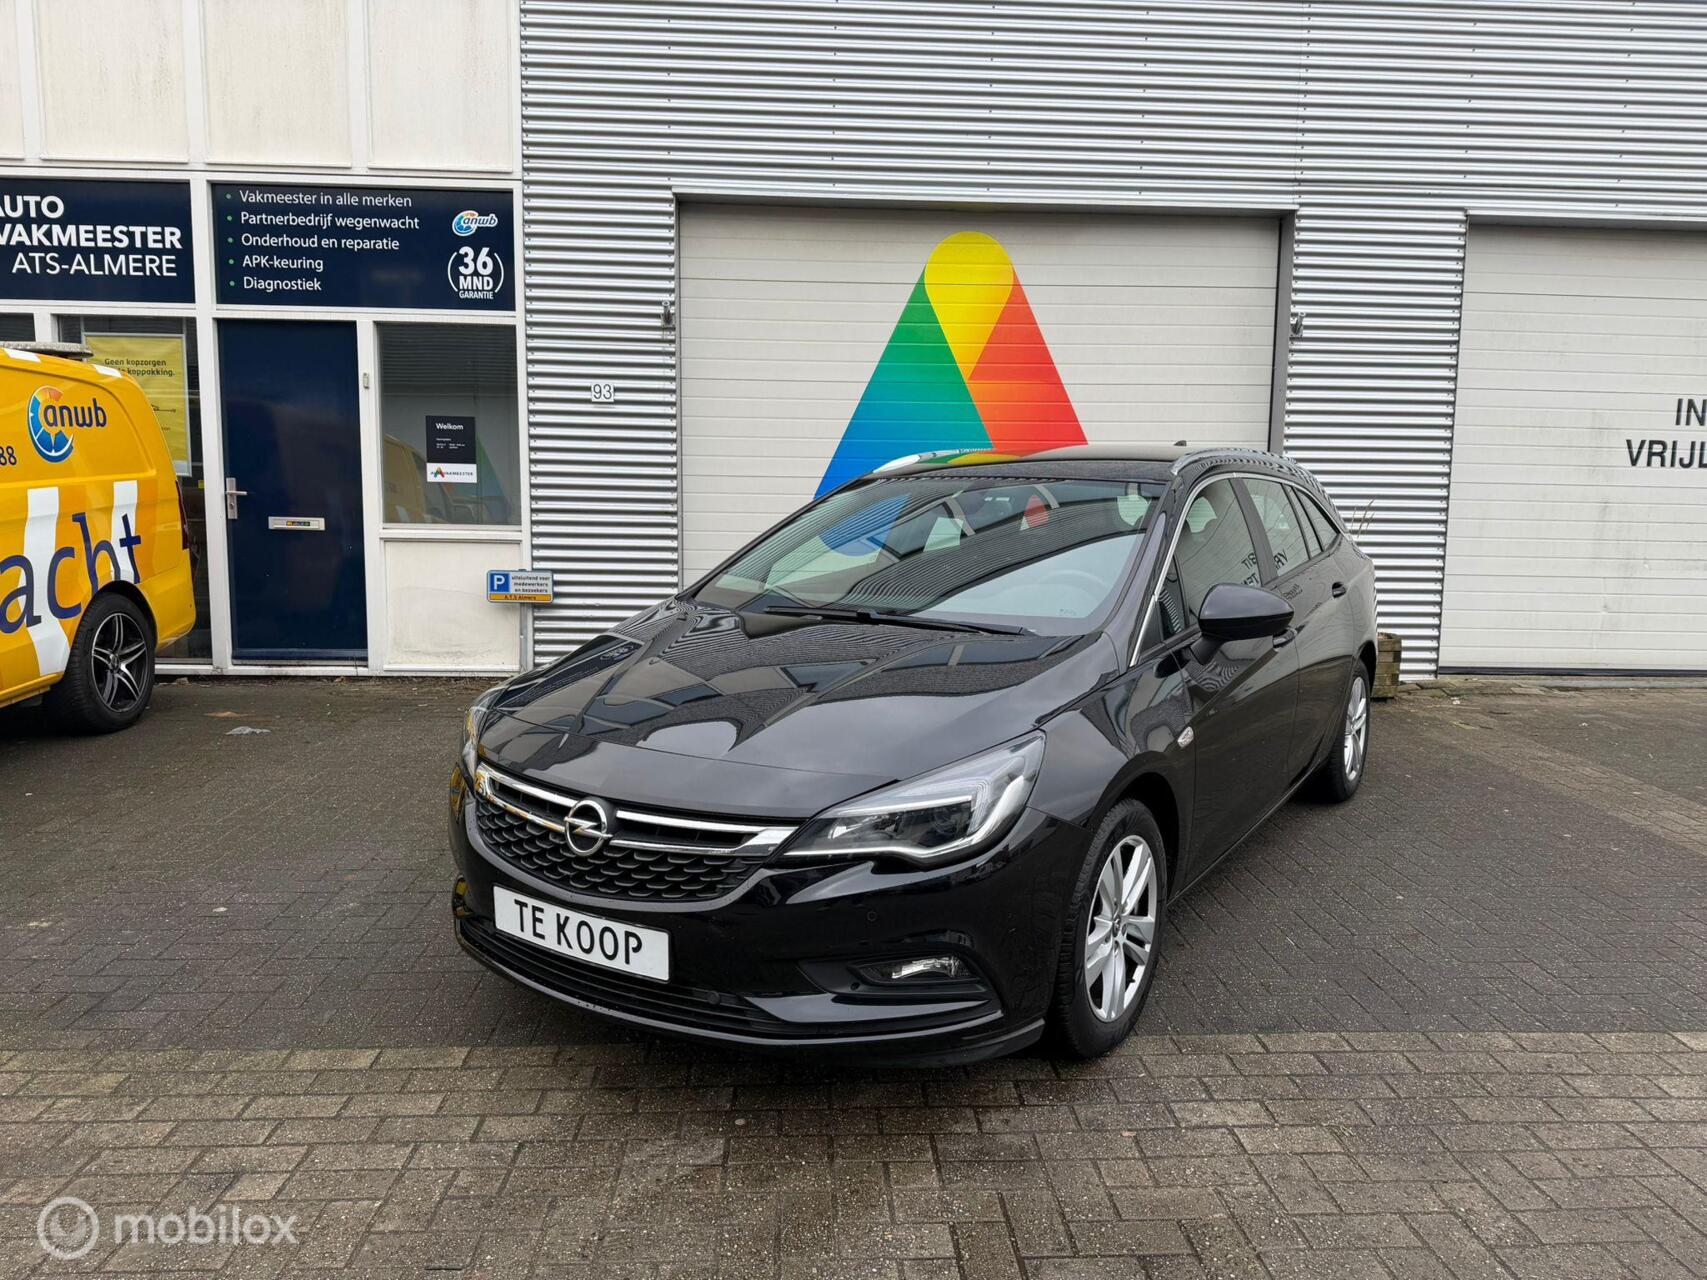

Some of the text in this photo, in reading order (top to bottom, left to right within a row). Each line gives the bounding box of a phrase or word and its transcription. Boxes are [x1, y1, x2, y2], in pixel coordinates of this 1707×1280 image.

[0, 195, 65, 218] UTO
[239, 190, 412, 207] Vakmeester in alle merken
[240, 212, 420, 230] Partnerbedrijf wegenwacht
[462, 215, 498, 226] anwb
[241, 233, 400, 251] Onderhoud en reparatie
[12, 252, 177, 277] ATS-ALMERE
[242, 255, 324, 272] APK-keuring
[458, 246, 494, 276] 36
[243, 276, 322, 292] Diagnostiek
[458, 275, 494, 291] MND
[458, 290, 494, 300] GARANTIE
[104, 358, 167, 367] Geen kopzorgen
[593, 383, 612, 400] 93
[43, 398, 107, 428] anwb
[1675, 398, 1707, 426] IN
[435, 422, 464, 430] Welkom
[1625, 439, 1707, 469] VRIJL
[493, 575, 505, 590] P
[514, 898, 643, 965] TE KOOP
